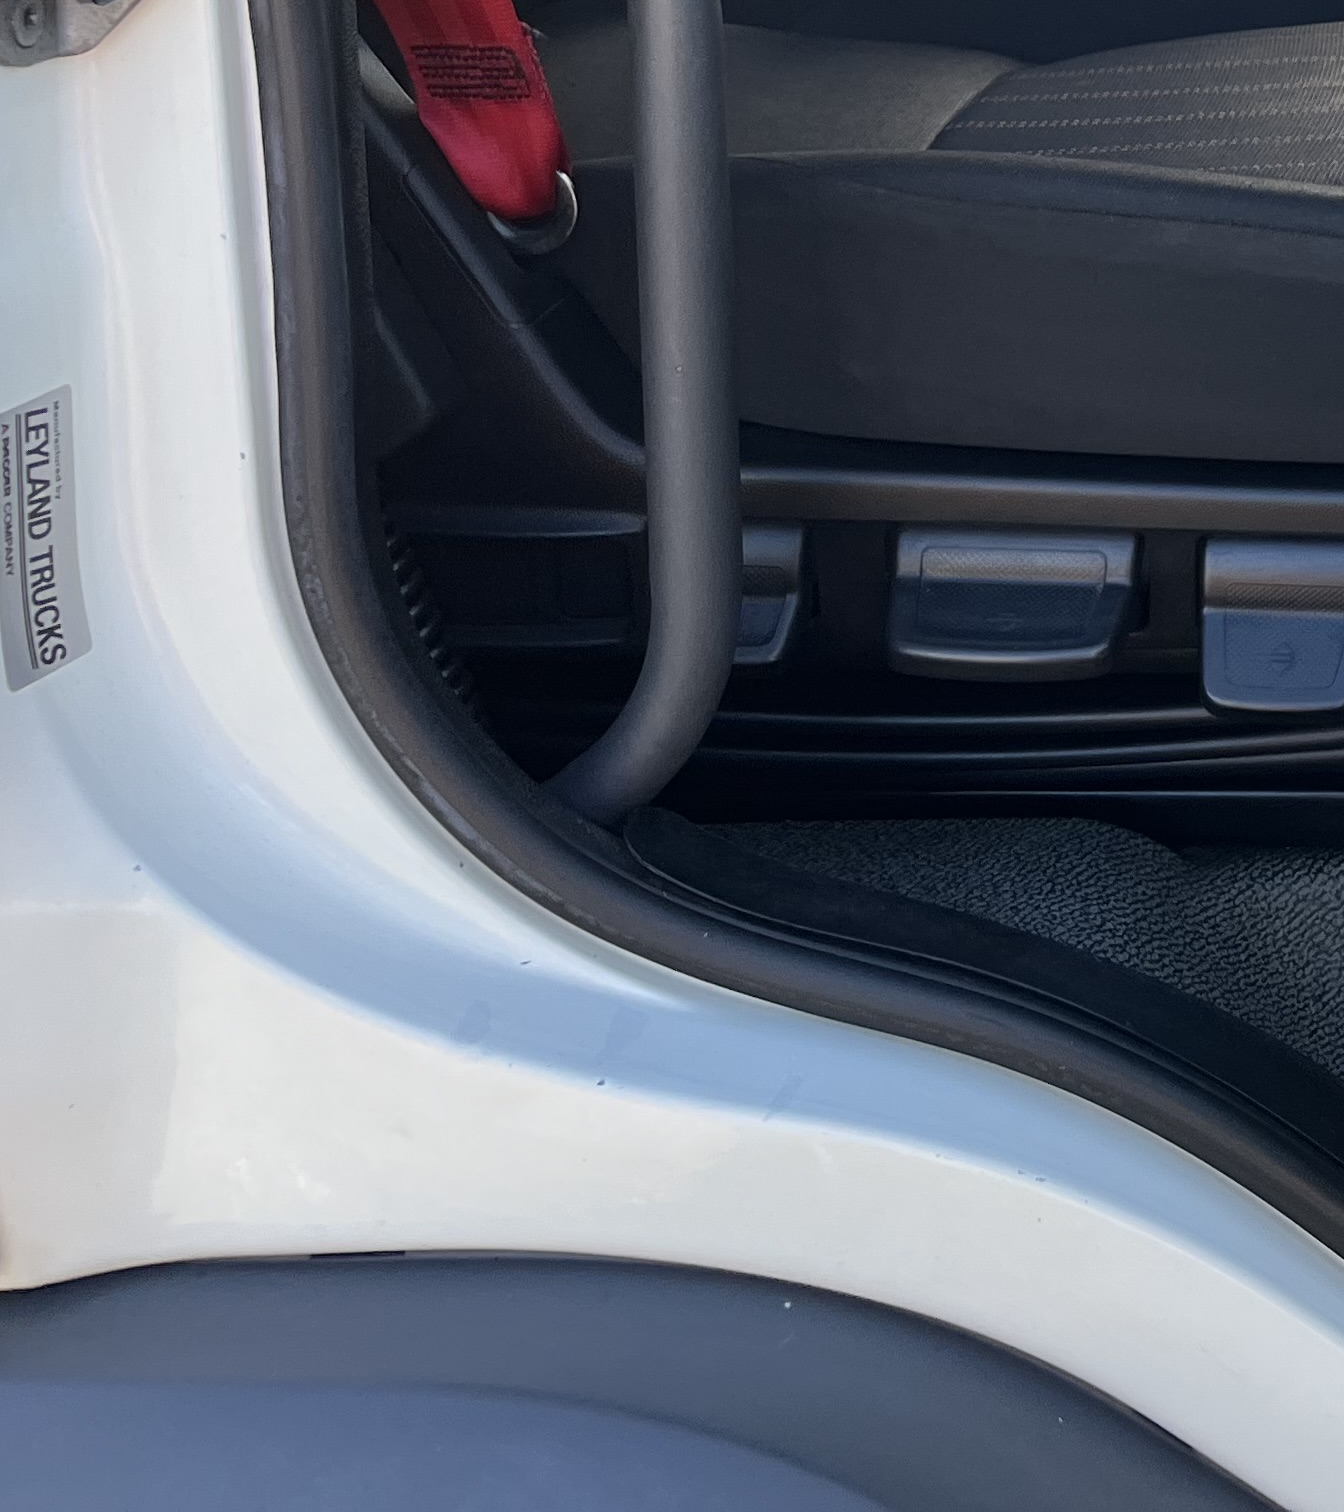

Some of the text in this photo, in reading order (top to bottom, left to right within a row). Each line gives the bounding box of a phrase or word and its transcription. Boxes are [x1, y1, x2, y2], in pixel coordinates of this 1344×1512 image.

[1, 424, 14, 577] A PACCAR COMPANY
[53, 400, 62, 500] Manufactured by
[25, 407, 67, 665] LEYLAND TRUCKS
